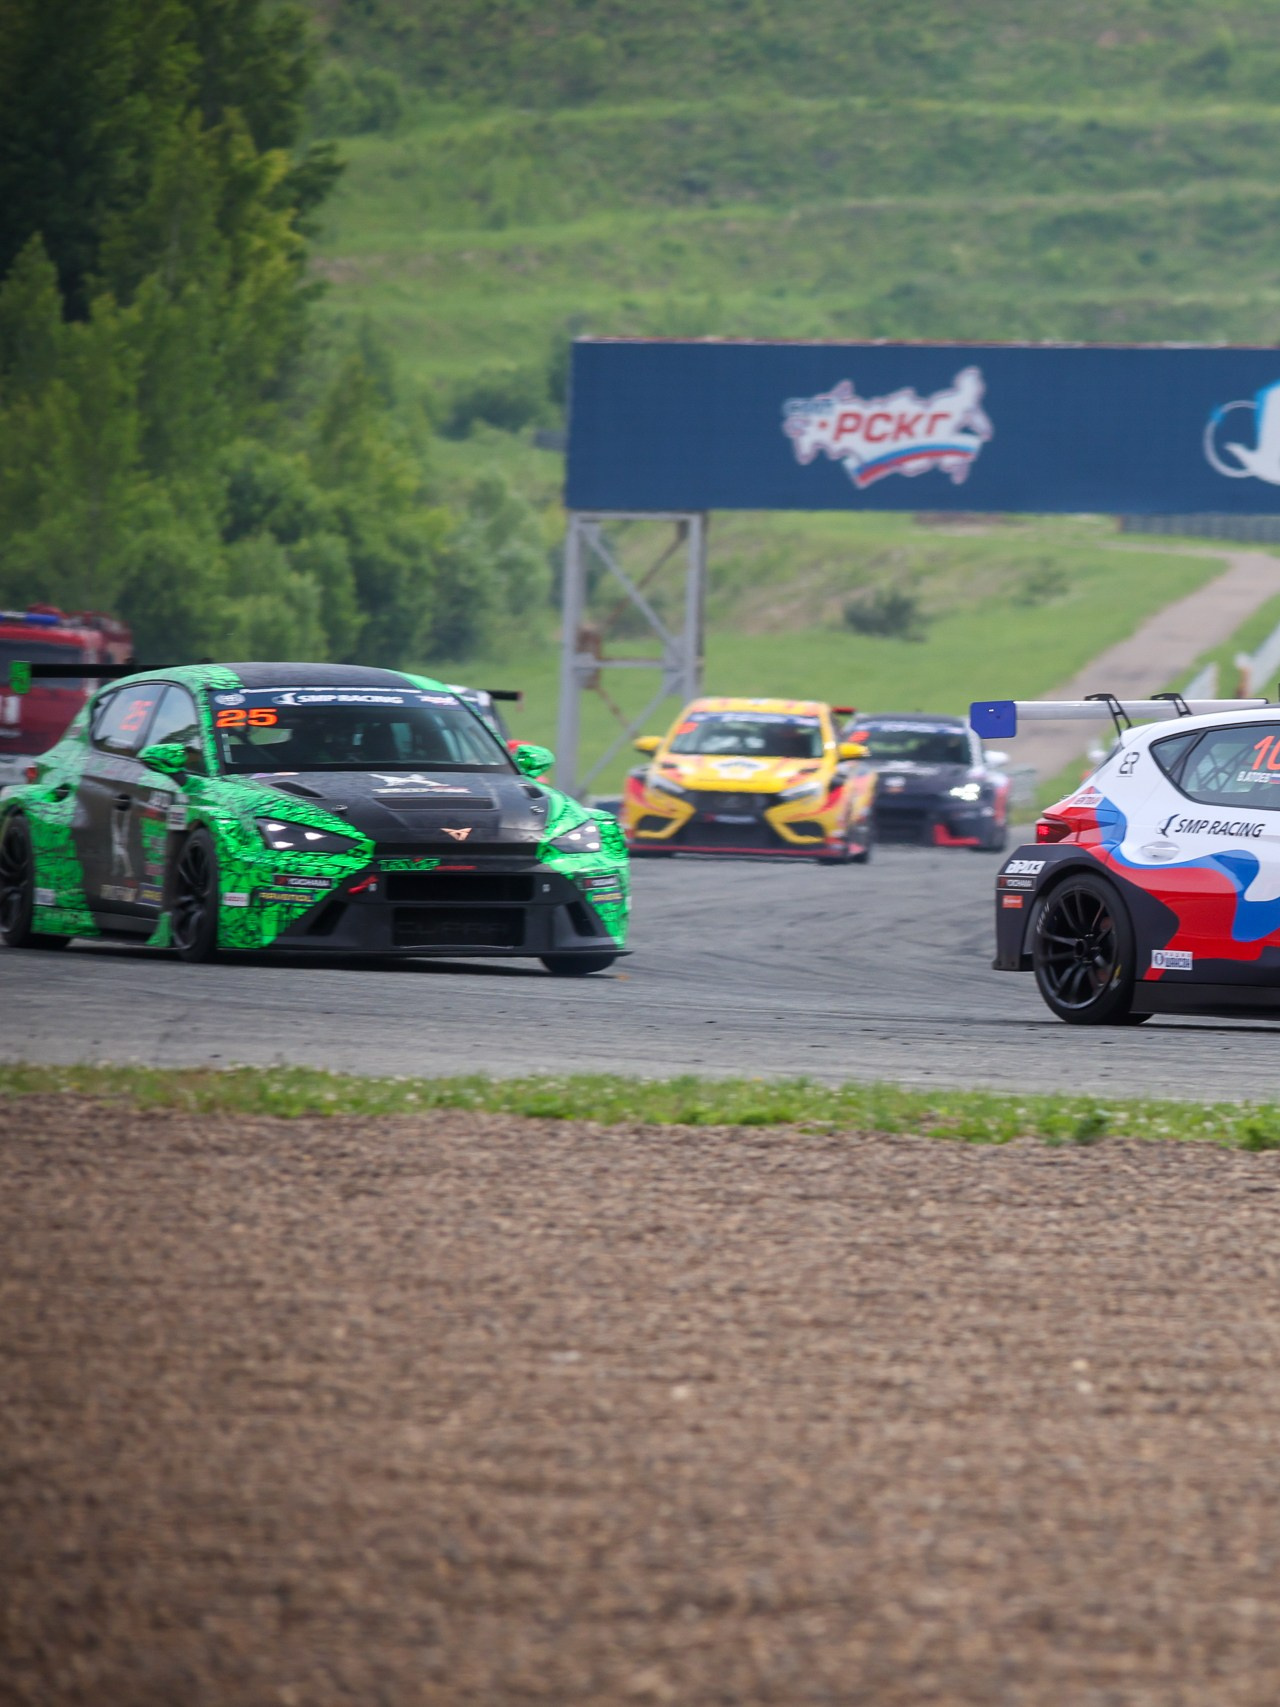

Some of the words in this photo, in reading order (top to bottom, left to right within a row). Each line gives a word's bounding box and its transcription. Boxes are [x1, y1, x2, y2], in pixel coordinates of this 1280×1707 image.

[832, 411, 953, 443] РСКГ
[215, 708, 279, 728] 25
[1175, 818, 1209, 835] SMP
[1208, 821, 1267, 838] RACING
